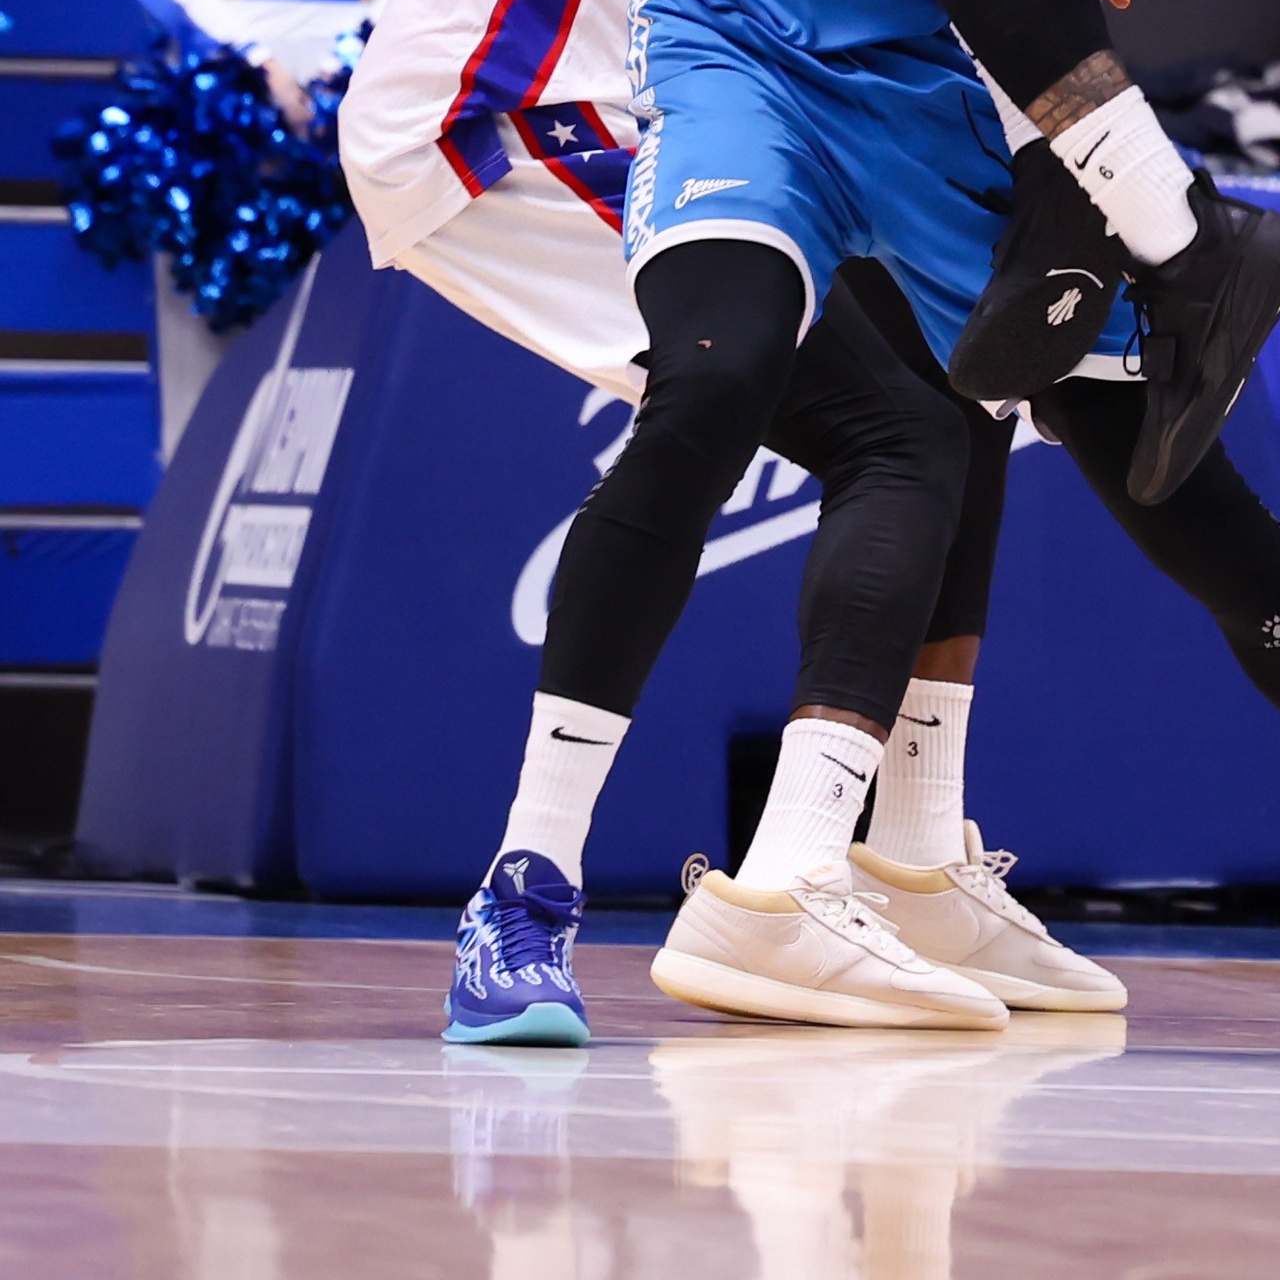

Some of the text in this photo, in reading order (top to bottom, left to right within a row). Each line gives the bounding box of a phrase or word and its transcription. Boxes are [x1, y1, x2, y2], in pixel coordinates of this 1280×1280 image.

[1098, 164, 1115, 181] 6
[907, 741, 919, 758] 3
[832, 783, 843, 798] 3
